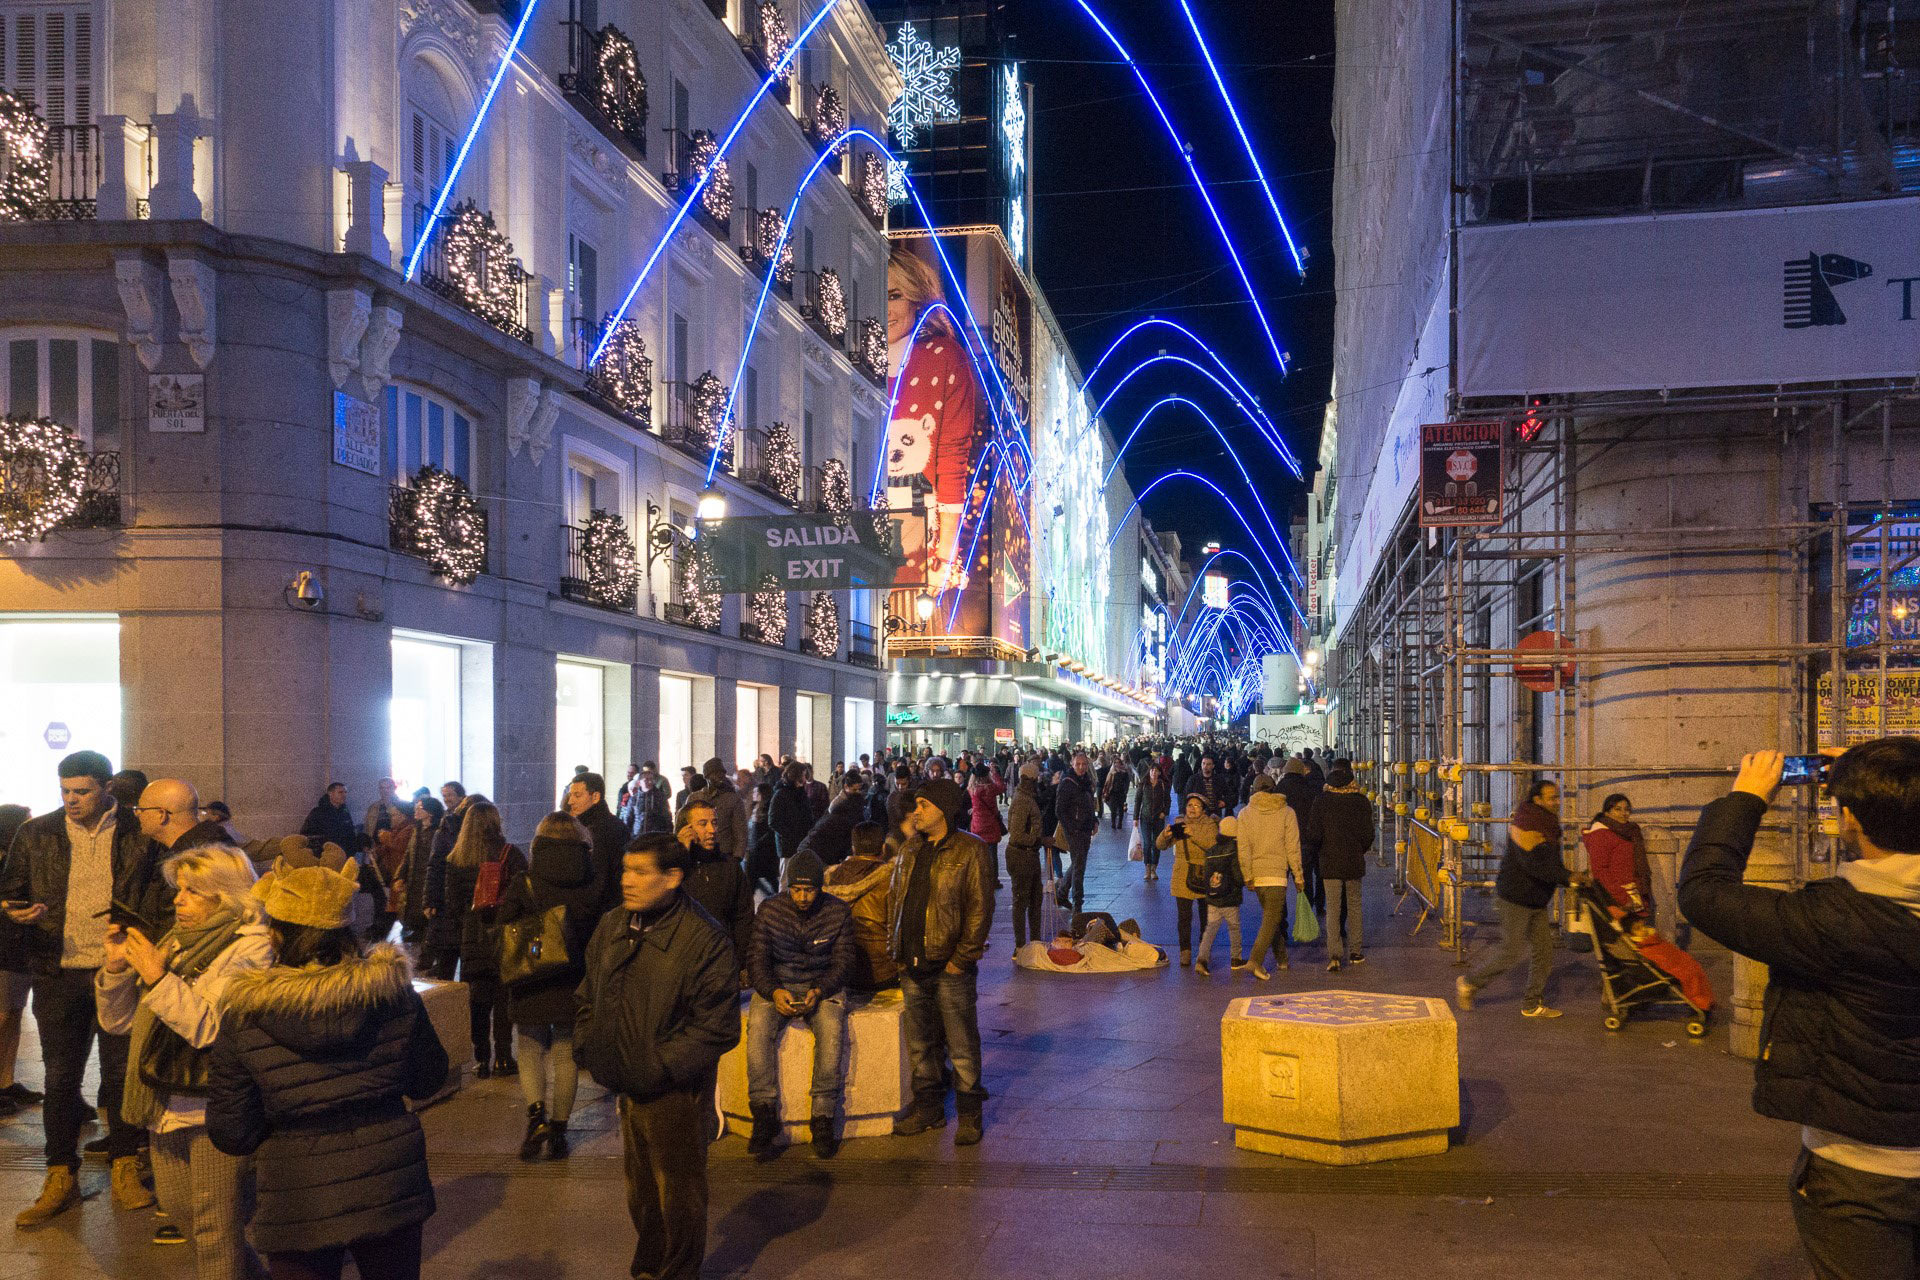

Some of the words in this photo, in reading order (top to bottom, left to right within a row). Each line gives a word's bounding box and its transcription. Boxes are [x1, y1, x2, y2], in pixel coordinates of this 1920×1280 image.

[992, 308, 1018, 360] gusta
[999, 341, 1029, 402] Navidad
[152, 408, 184, 418] PUERTA
[166, 418, 187, 428] SOL
[766, 525, 861, 548] SALIDA
[787, 558, 844, 580] EXIT
[1309, 558, 1317, 591] Locker
[1308, 593, 1317, 615] Foot
